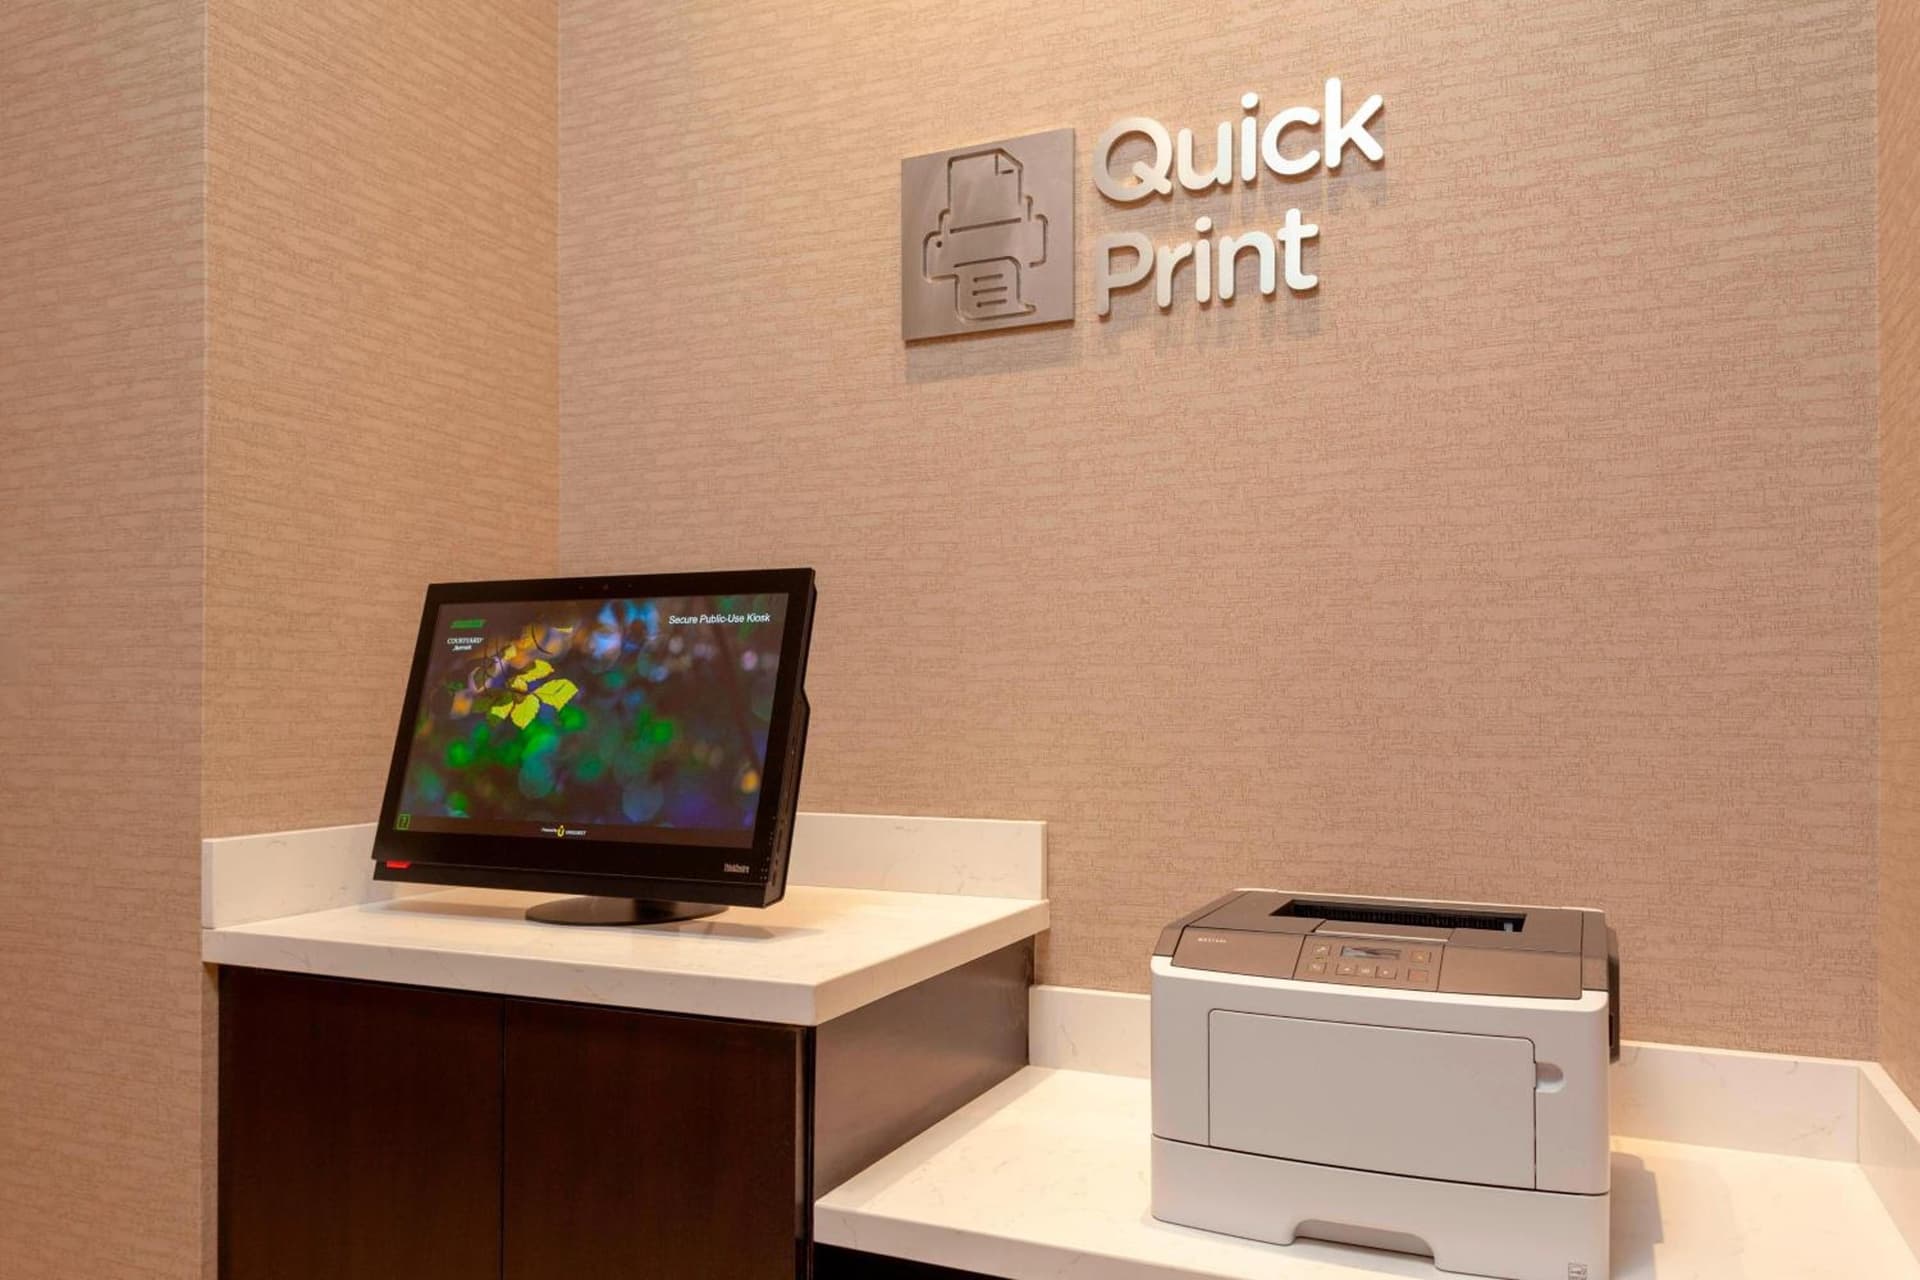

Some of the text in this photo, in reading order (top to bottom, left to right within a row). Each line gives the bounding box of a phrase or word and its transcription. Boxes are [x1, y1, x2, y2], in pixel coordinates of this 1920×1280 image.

[1093, 77, 1385, 203] Quick
[1096, 208, 1320, 317] Print
[668, 612, 771, 625] Secure Public-Use Kiosk
